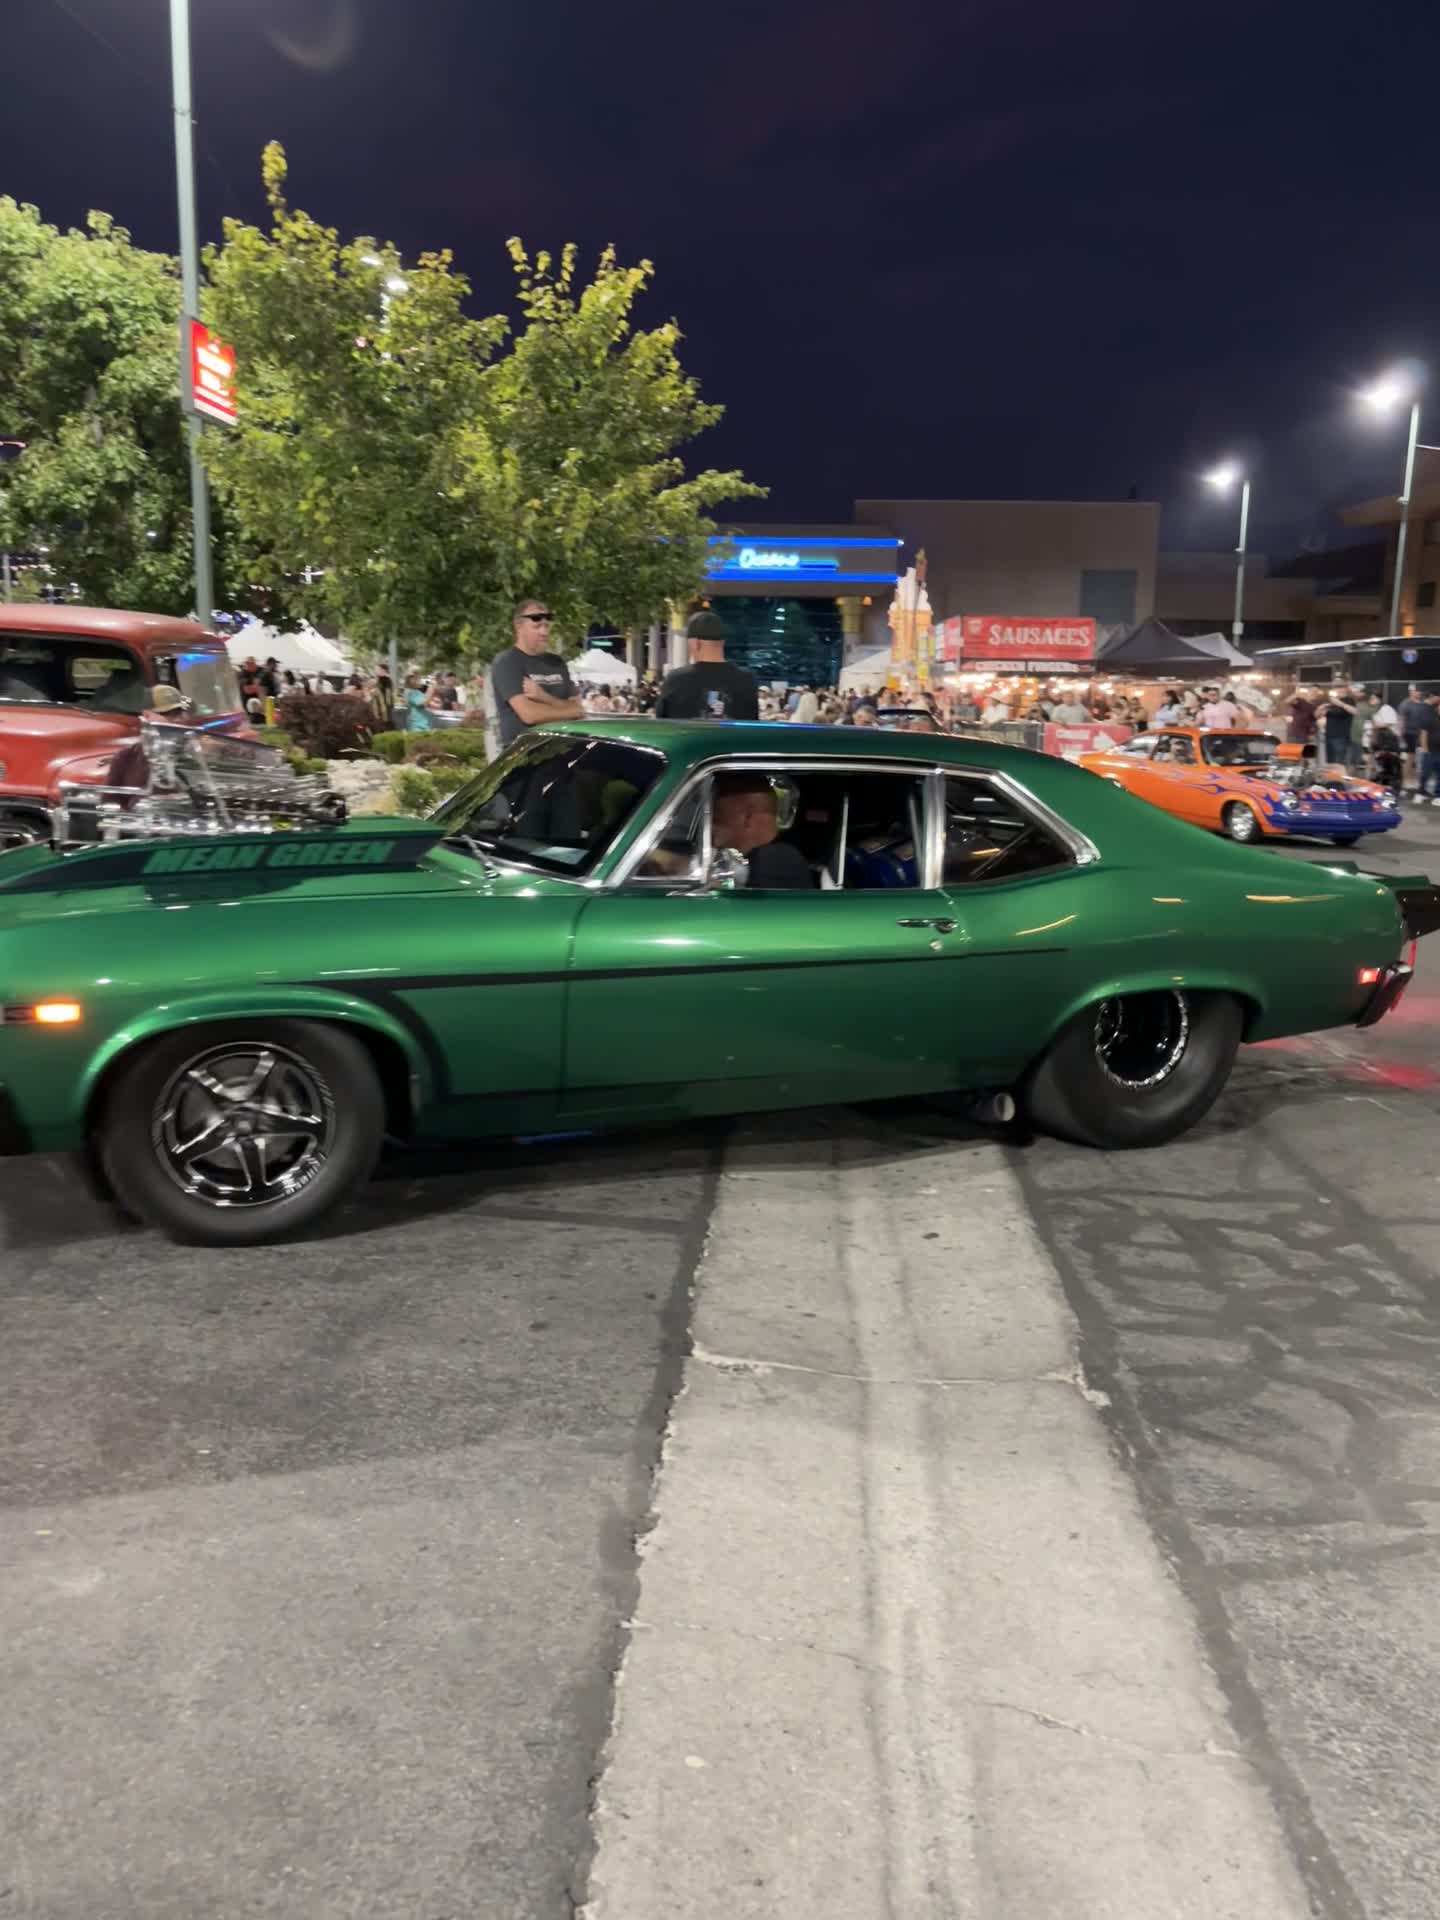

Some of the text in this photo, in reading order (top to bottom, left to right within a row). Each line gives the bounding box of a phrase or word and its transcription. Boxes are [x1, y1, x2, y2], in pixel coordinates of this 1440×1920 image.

[989, 624, 1090, 647] SAUSAGES
[144, 842, 394, 873] MEAN GREEN
